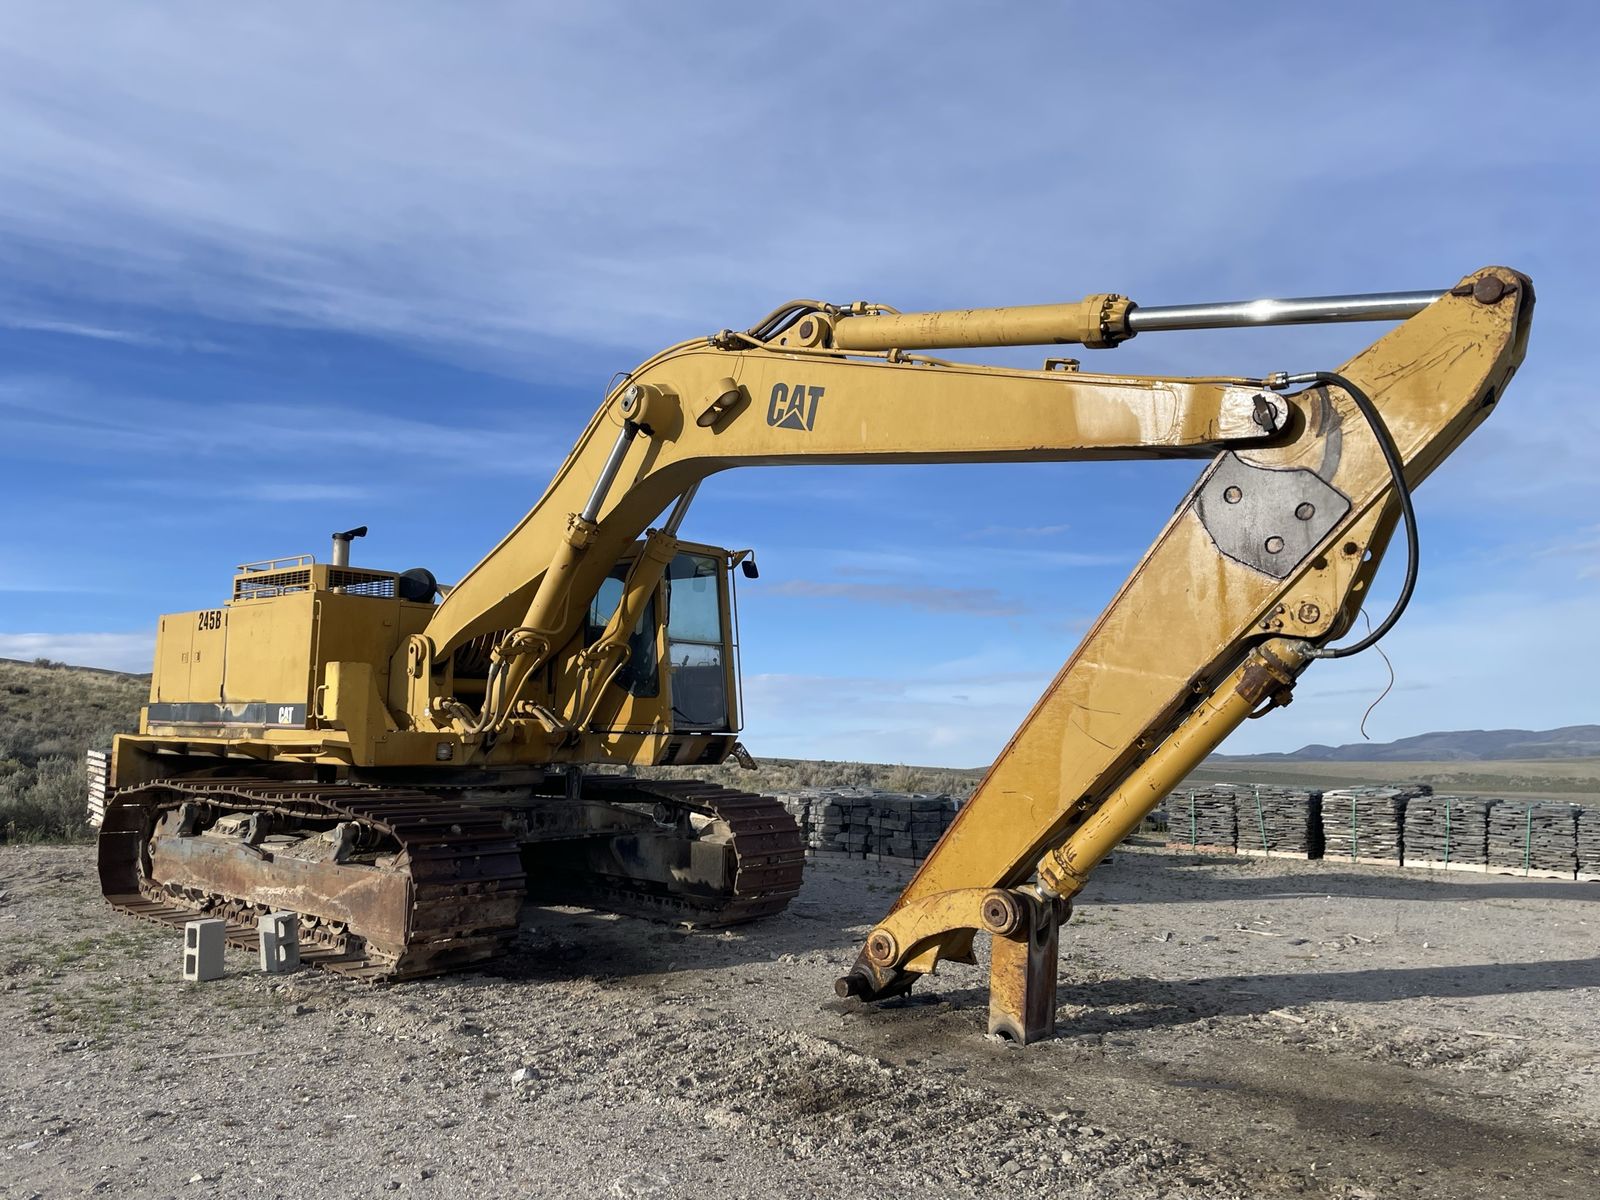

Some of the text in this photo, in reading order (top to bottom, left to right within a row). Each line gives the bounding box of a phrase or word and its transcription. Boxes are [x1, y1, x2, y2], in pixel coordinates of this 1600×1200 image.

[767, 382, 825, 431] CAT
[198, 610, 222, 631] 245B
[278, 706, 294, 724] CAT
